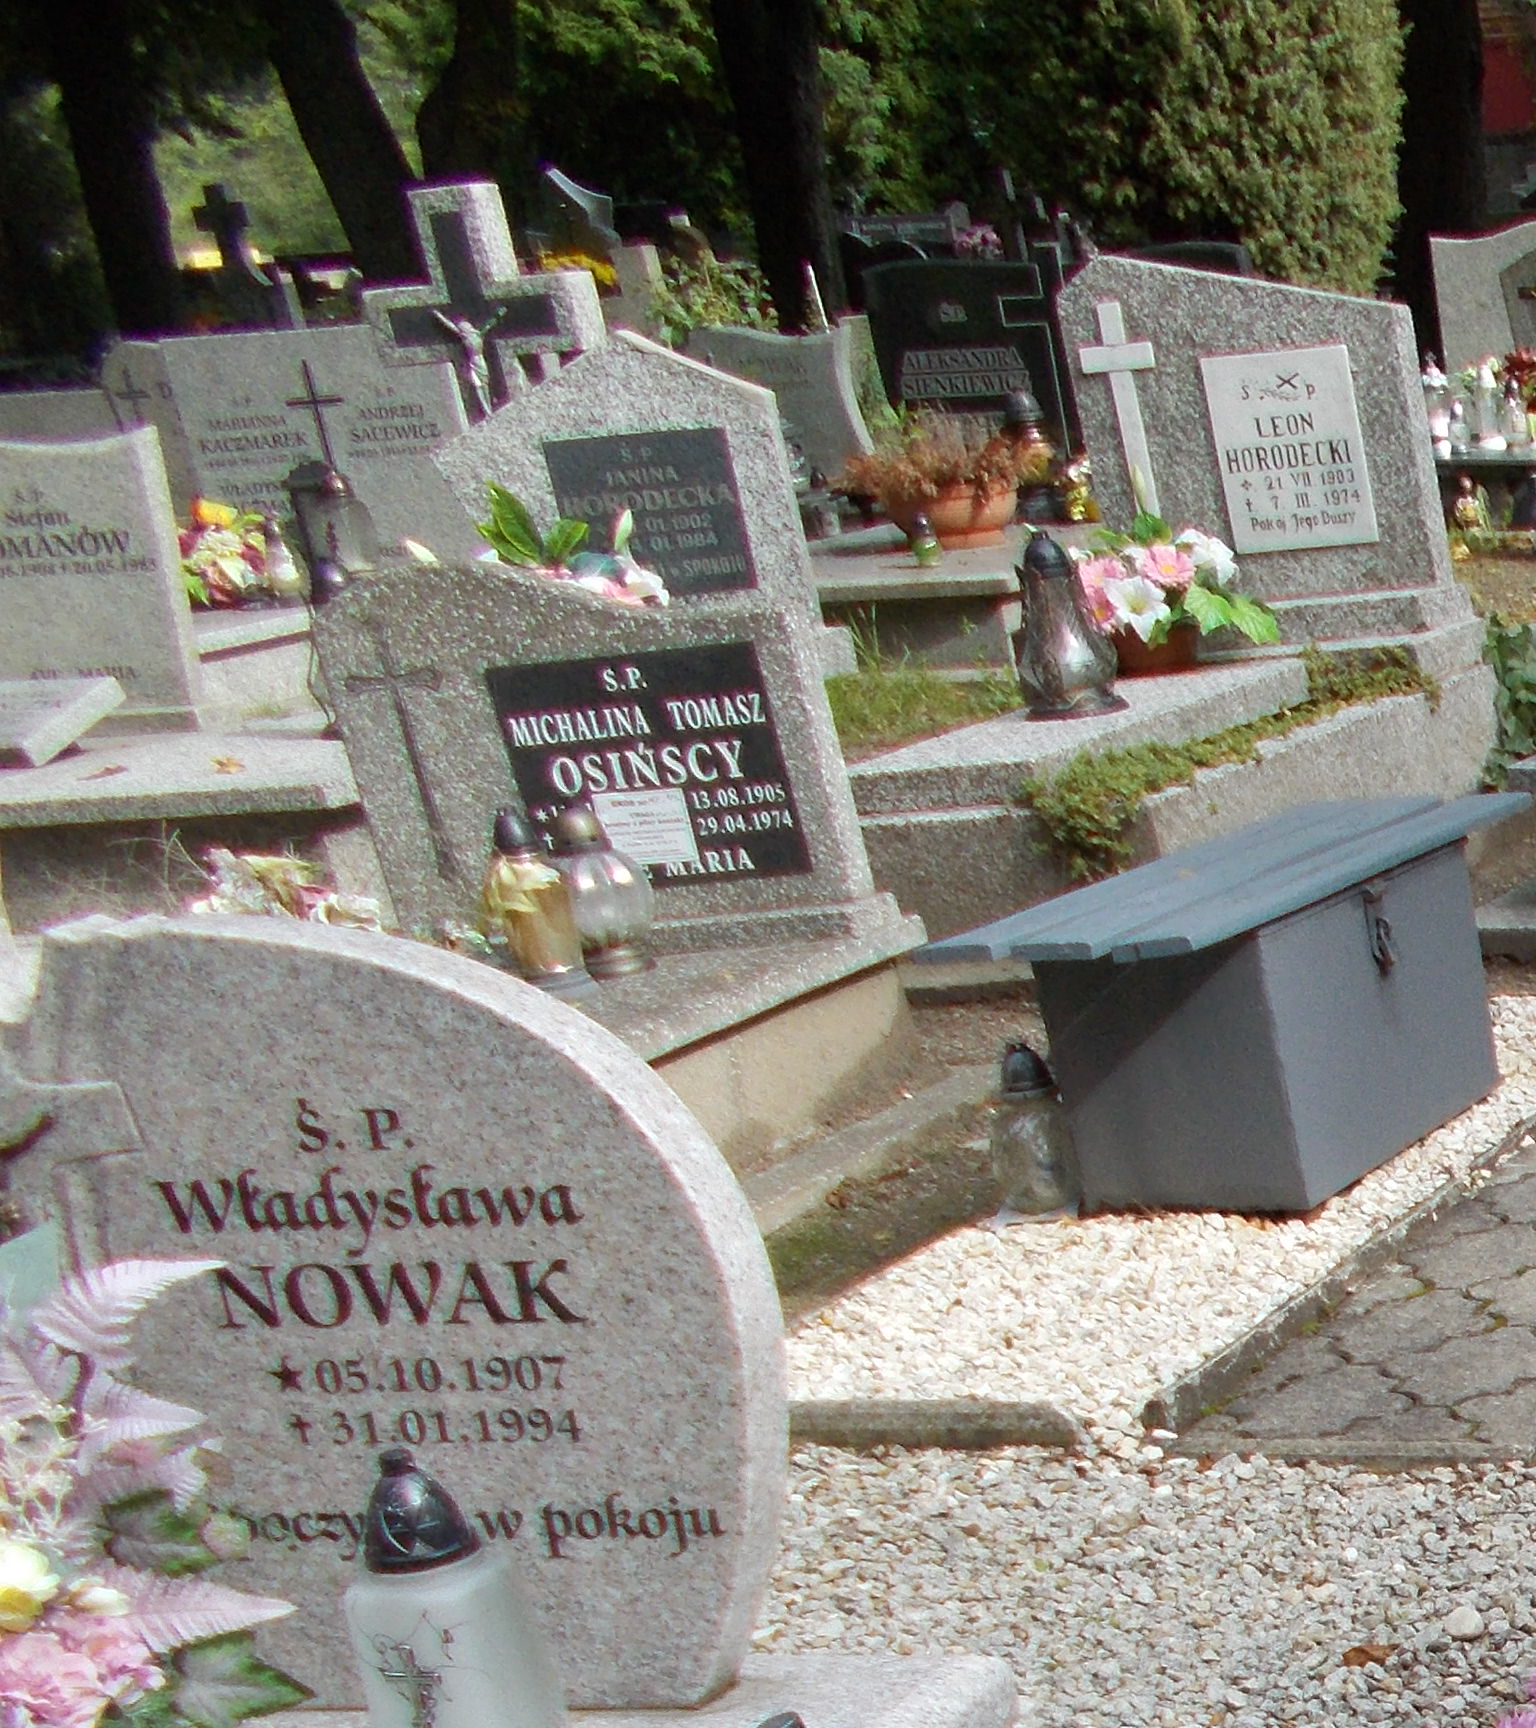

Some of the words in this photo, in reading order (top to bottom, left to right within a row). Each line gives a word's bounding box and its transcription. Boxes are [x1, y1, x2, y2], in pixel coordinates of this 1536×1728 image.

[903, 346, 1024, 371] ALEKSANDRA
[903, 370, 1030, 399] SIENKIEWICZ
[1254, 412, 1316, 438] LEON
[1225, 439, 1354, 474] HORODECKI
[1323, 488, 1362, 507] 1974
[509, 704, 652, 748] MICHALINA
[666, 692, 767, 732] TOMASZ
[551, 739, 746, 797] OSIŃSCY
[690, 785, 787, 811] 13.08.1905
[696, 810, 795, 839] 29.04.1974
[156, 1162, 587, 1258] Władysława
[214, 1257, 591, 1331] NOWAK
[314, 1353, 569, 1396] 05.10.1907
[331, 1406, 586, 1446] 31.01.1994
[477, 1508, 525, 1538] w
[540, 1492, 727, 1560] pokoju
